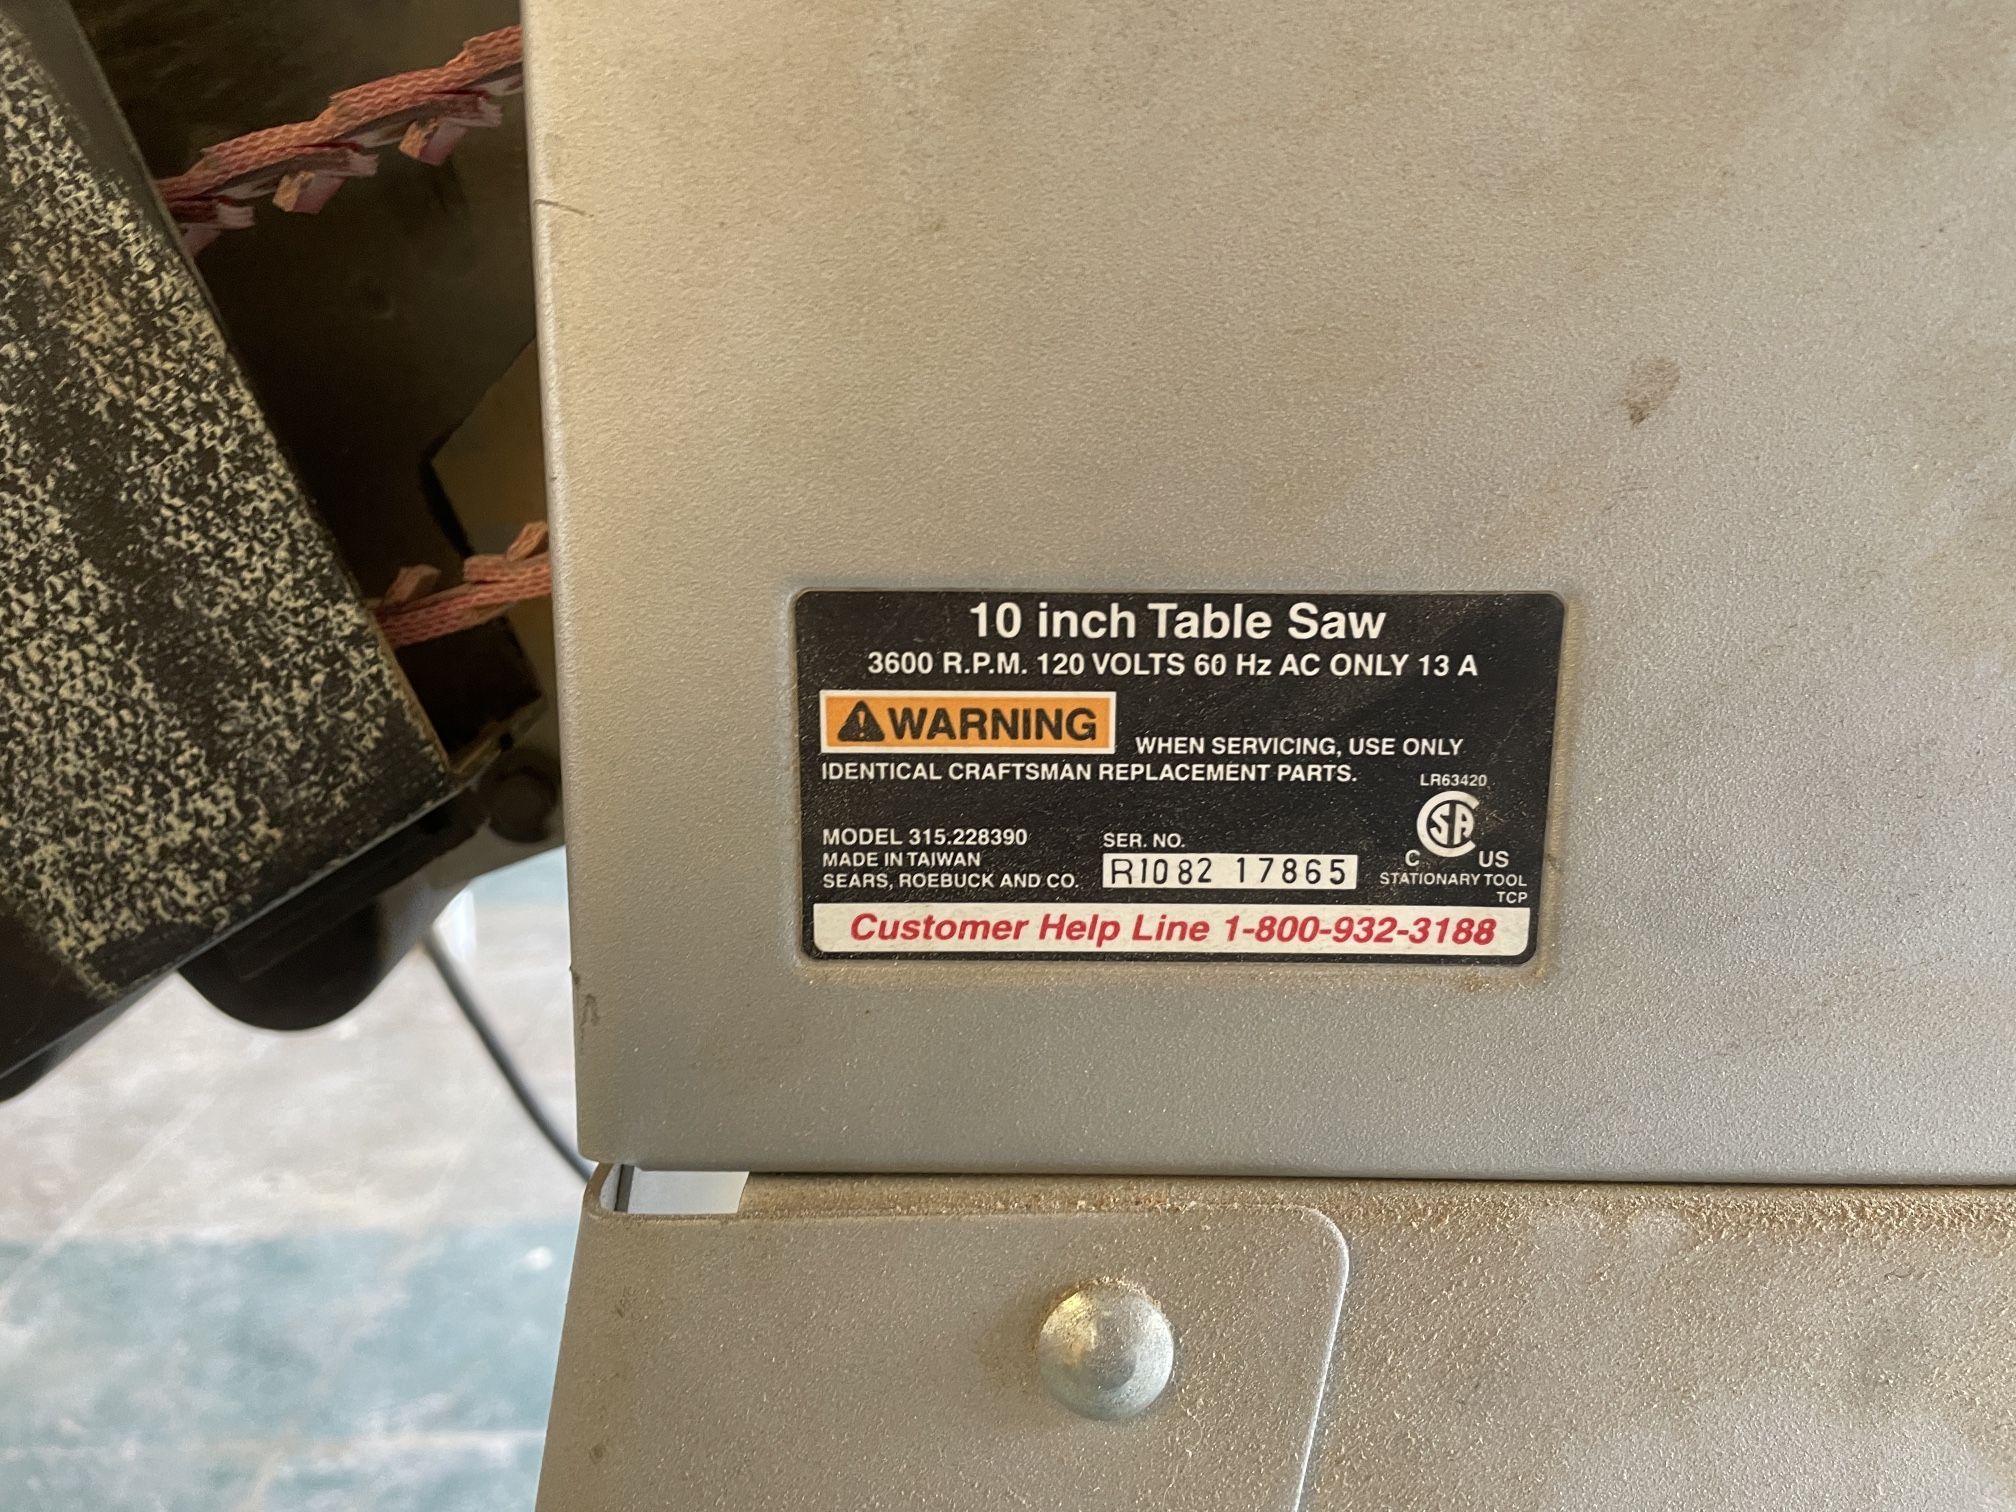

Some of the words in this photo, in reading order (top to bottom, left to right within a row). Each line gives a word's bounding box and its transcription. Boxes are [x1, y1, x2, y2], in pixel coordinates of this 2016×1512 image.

[970, 602, 1022, 639] 10
[1038, 602, 1136, 639] inch
[1148, 602, 1272, 640] Table
[1287, 602, 1387, 640] Saw
[867, 652, 933, 675] 3600
[943, 652, 1028, 675] R.P.M.
[1037, 653, 1085, 676] 120
[1092, 653, 1186, 677] VOLTS
[1194, 653, 1227, 676] 60
[1236, 653, 1272, 677] Hz
[1279, 653, 1321, 677] AC
[1329, 654, 1410, 677] ONLY
[1419, 655, 1450, 677] 13
[1457, 655, 1479, 677] A
[888, 707, 1097, 741] WARNING
[1135, 737, 1205, 755] WHEN
[1211, 737, 1342, 758] SERVICING,
[1348, 738, 1396, 756] USE
[1402, 738, 1464, 756] ONLY
[821, 763, 942, 781] IDENTICAL
[948, 763, 1092, 781] CRAFTSMAN
[1098, 764, 1271, 782] REPLACEMENT
[1277, 764, 1357, 783] PARTS.
[1419, 773, 1488, 787] LR63420
[822, 829, 902, 846] MODEL
[908, 829, 1028, 846] 315.228390
[1103, 833, 1147, 848] SER.
[1153, 833, 1186, 849] NO.
[822, 852, 878, 867] MADE
[884, 853, 902, 867] IN
[908, 853, 981, 868] TAIWAN
[1478, 851, 1510, 868] US
[1236, 857, 1347, 885] 17865
[1379, 872, 1480, 886] STATIONARY
[1484, 873, 1528, 887] TOOL
[822, 873, 894, 891] SEARS,
[899, 873, 995, 888] ROEBUCK
[999, 873, 1041, 888] AND
[1046, 873, 1080, 889] CO.
[1496, 890, 1528, 904] TCP
[850, 913, 1030, 941] Customer
[1038, 914, 1121, 948] Help
[1131, 914, 1211, 942] Line
[1225, 915, 1497, 946] 1-800-932-3188
